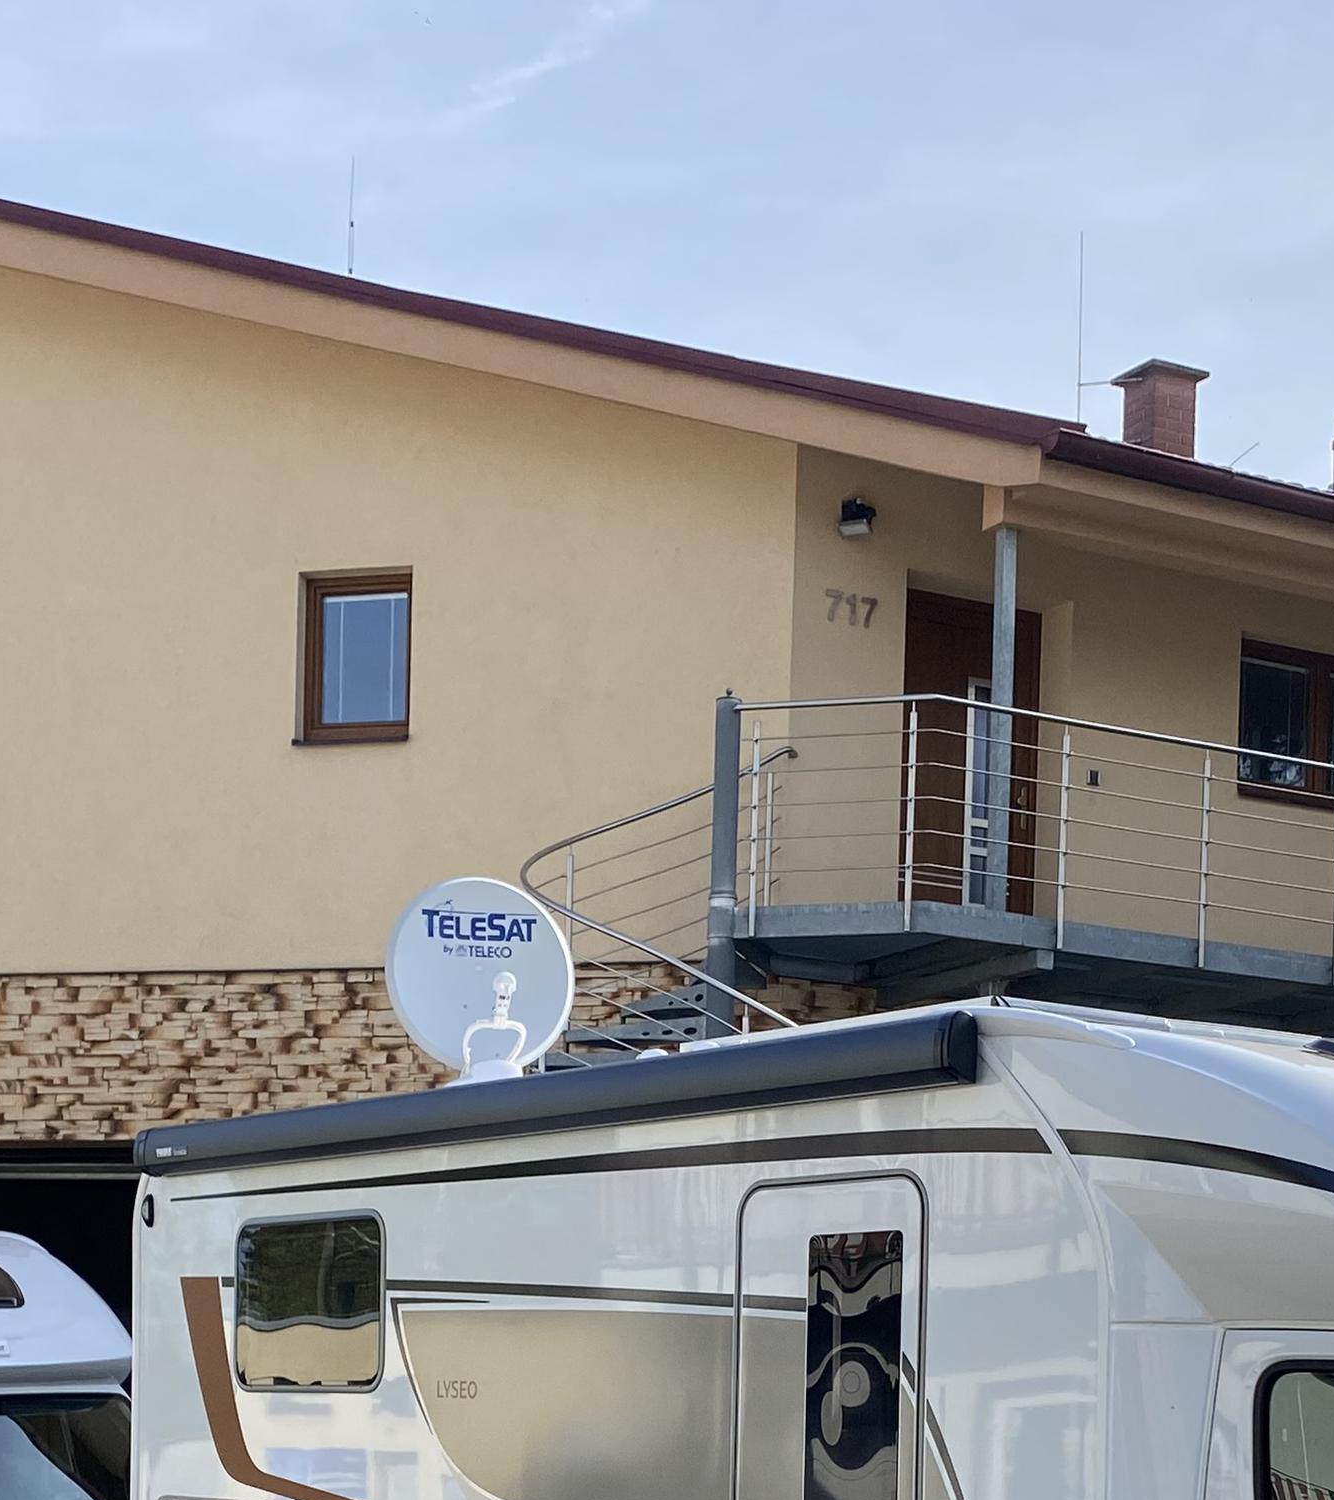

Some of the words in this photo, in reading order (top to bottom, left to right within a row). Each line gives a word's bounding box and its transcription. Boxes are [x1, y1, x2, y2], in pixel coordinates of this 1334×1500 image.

[825, 589, 878, 629] 717
[443, 945, 453, 955] by
[469, 945, 512, 959] TELECO
[437, 1379, 478, 1400] LYSEO
